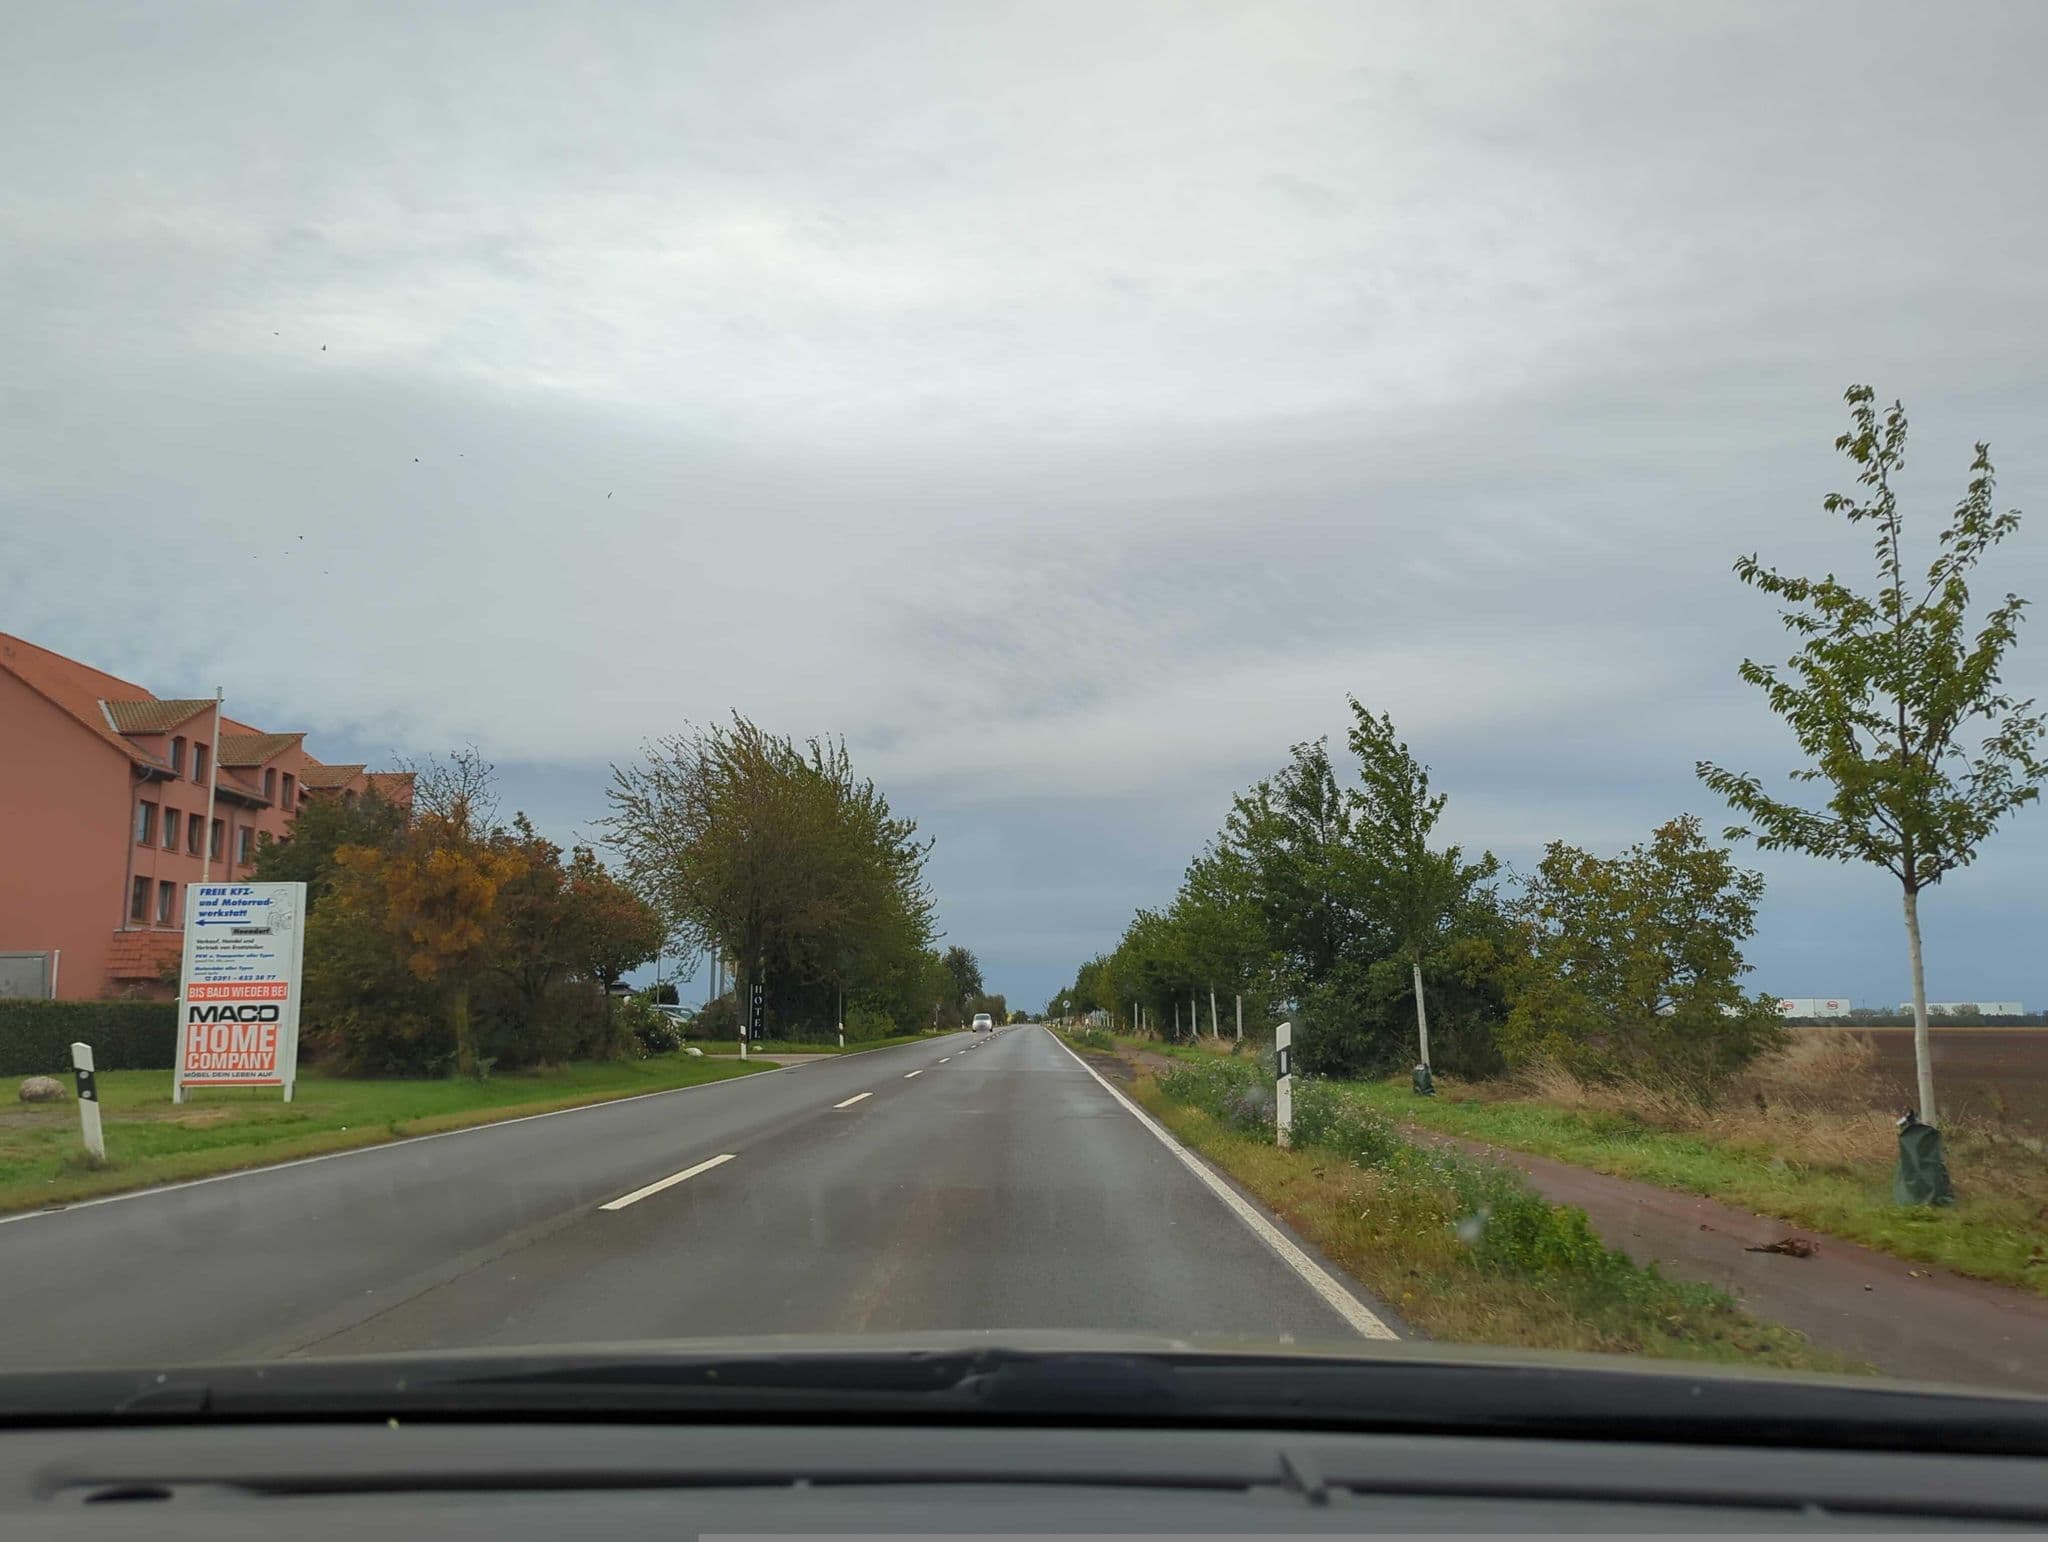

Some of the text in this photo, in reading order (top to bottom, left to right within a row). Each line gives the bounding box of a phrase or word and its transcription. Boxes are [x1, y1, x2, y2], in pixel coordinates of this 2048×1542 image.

[199, 888, 253, 896] FREIE KFZ-
[221, 898, 272, 906] Motorrad-
[189, 985, 287, 998] BIS BALD WIEDER BEI
[189, 1005, 279, 1023] MACO
[754, 985, 762, 1038] HOTEL
[189, 1025, 275, 1052] HOME
[188, 1053, 272, 1069] COMPANY
